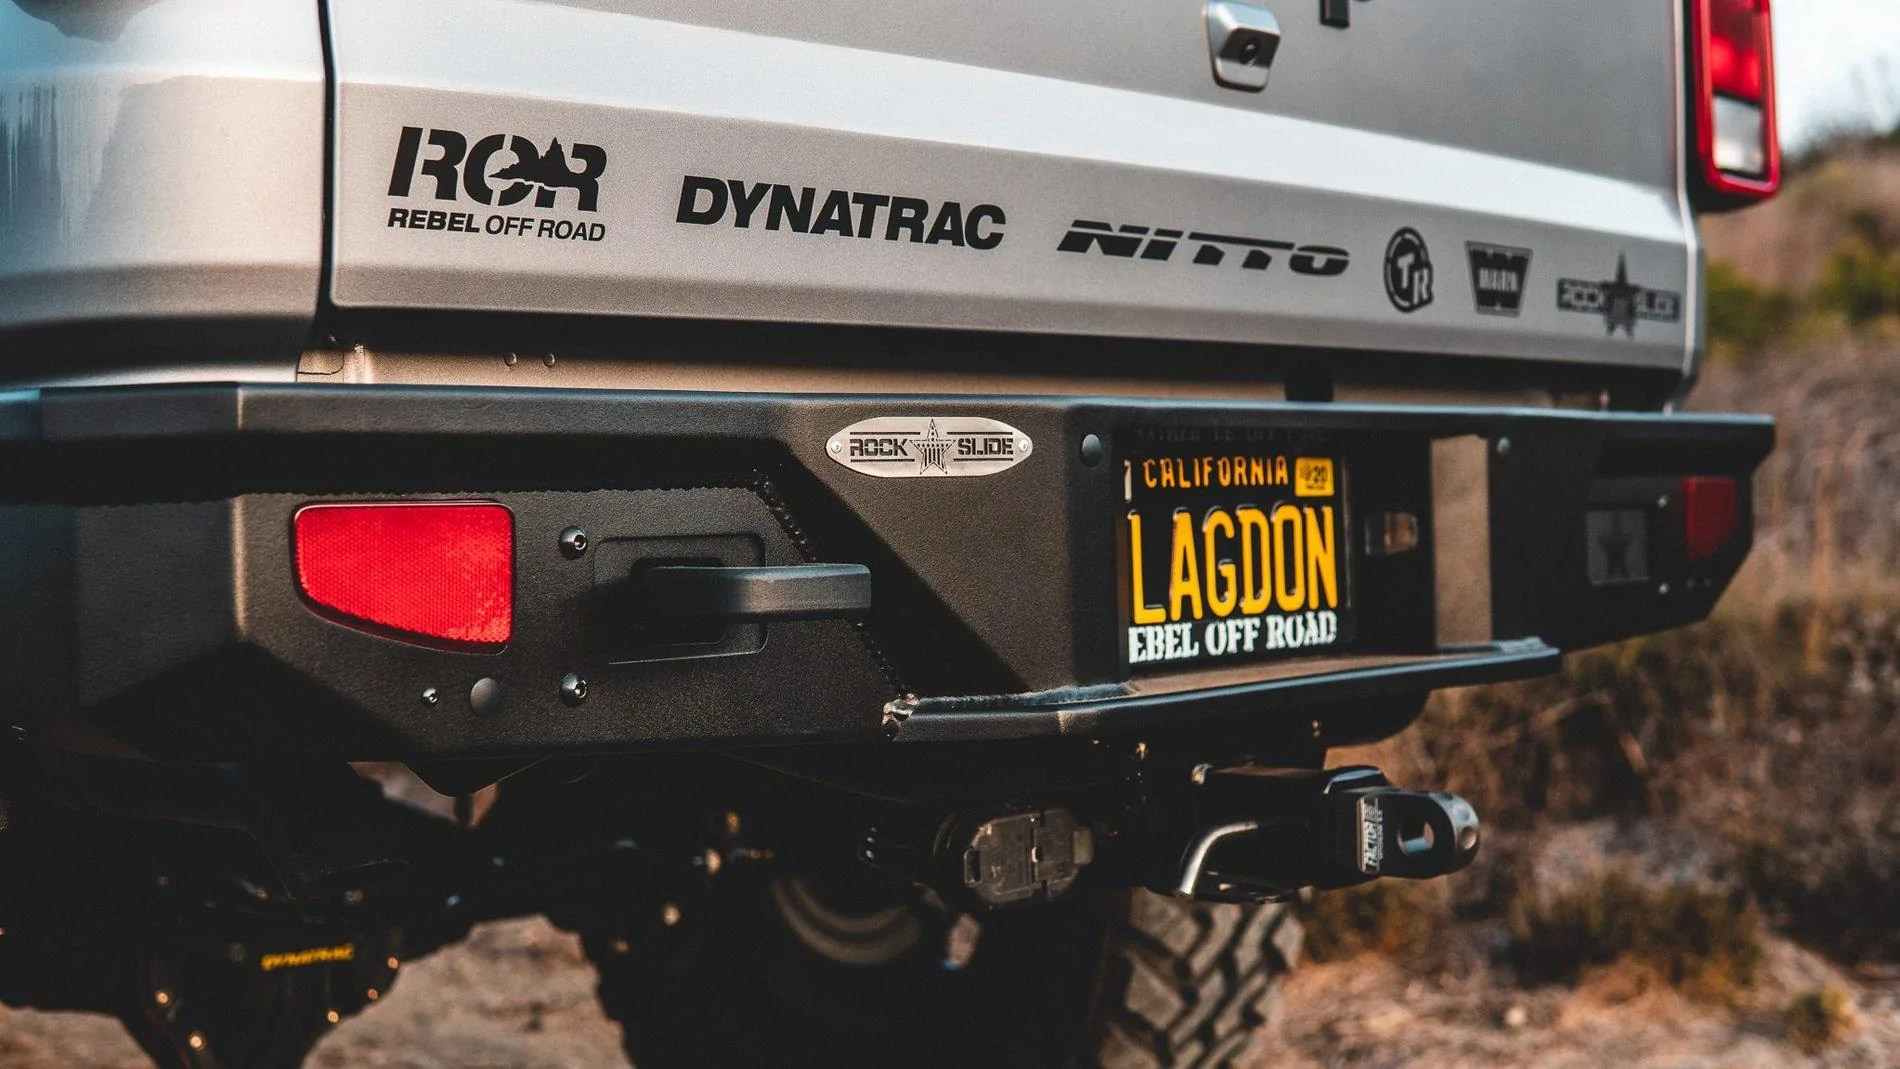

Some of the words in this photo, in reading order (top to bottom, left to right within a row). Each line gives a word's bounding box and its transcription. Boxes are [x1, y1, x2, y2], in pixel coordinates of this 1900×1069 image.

[387, 126, 607, 213] ROR
[387, 207, 481, 233] REBEL
[485, 214, 535, 237] OFF
[537, 218, 606, 242] ROAD
[675, 175, 1006, 251] DYNATRAC
[1056, 219, 1350, 277] NITTO
[849, 438, 909, 457] ROCK
[957, 437, 1014, 456] SLIDE
[1142, 455, 1289, 489] CALIFORNIA
[1127, 503, 1338, 625] LAGDON
[1127, 621, 1200, 664] EBEL
[1204, 617, 1261, 656] OFF
[1265, 610, 1338, 650] ROAD
